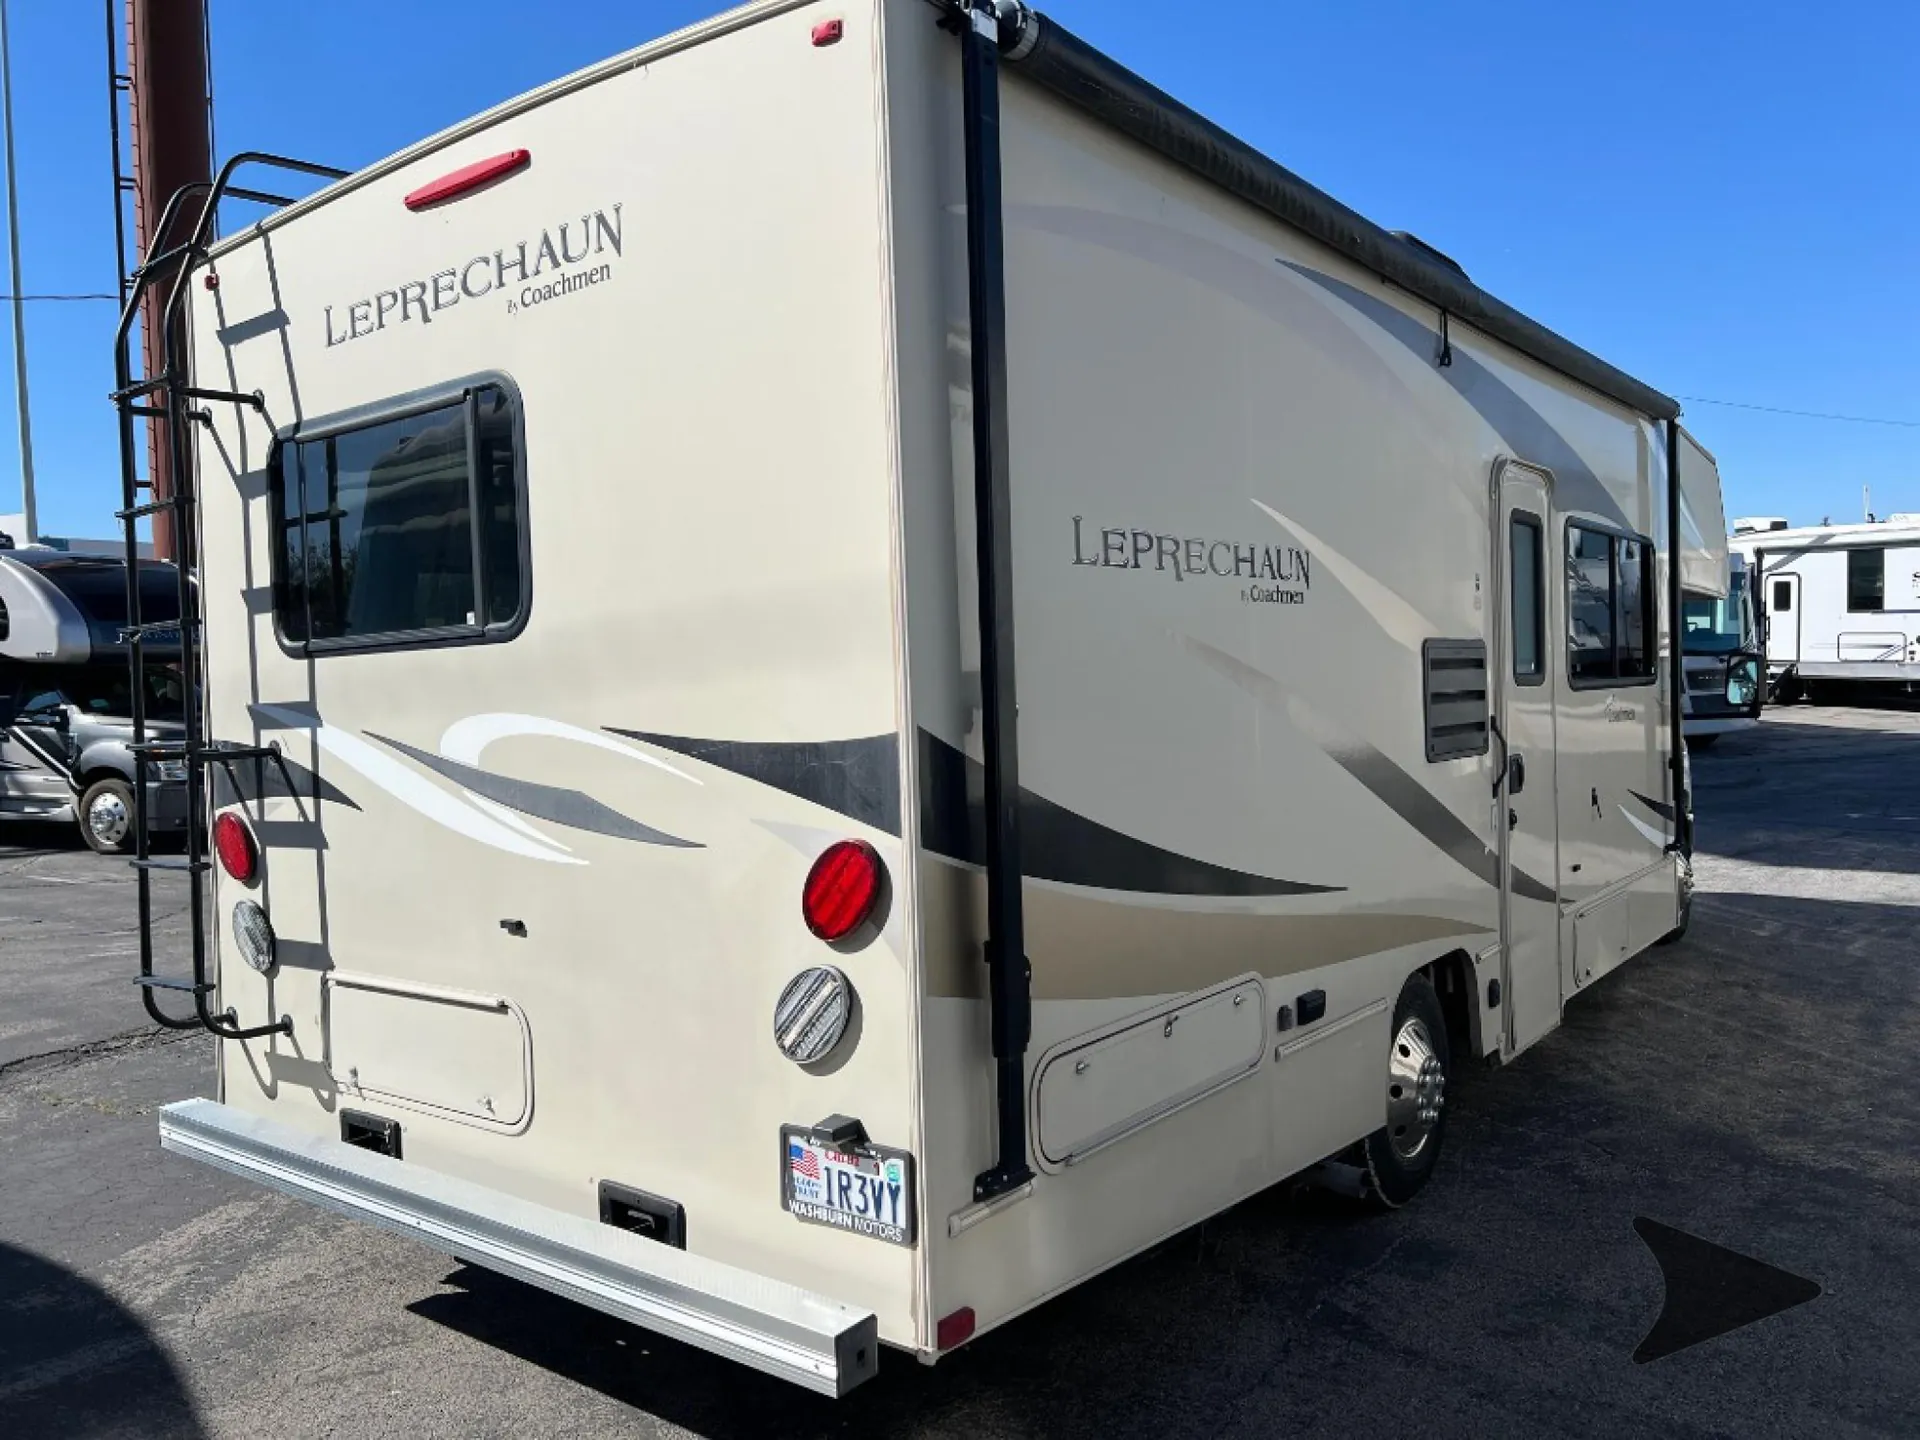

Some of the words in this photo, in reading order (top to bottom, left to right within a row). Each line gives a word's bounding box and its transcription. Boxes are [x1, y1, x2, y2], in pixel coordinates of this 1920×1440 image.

[324, 202, 623, 348] LEPRECHAUN
[520, 263, 612, 309] Coachmen
[1072, 515, 1311, 589] LEPRECHAUN
[1250, 584, 1304, 604] Coachmen
[788, 1199, 852, 1229] WASHBURN
[854, 1217, 903, 1242] MOTORS
